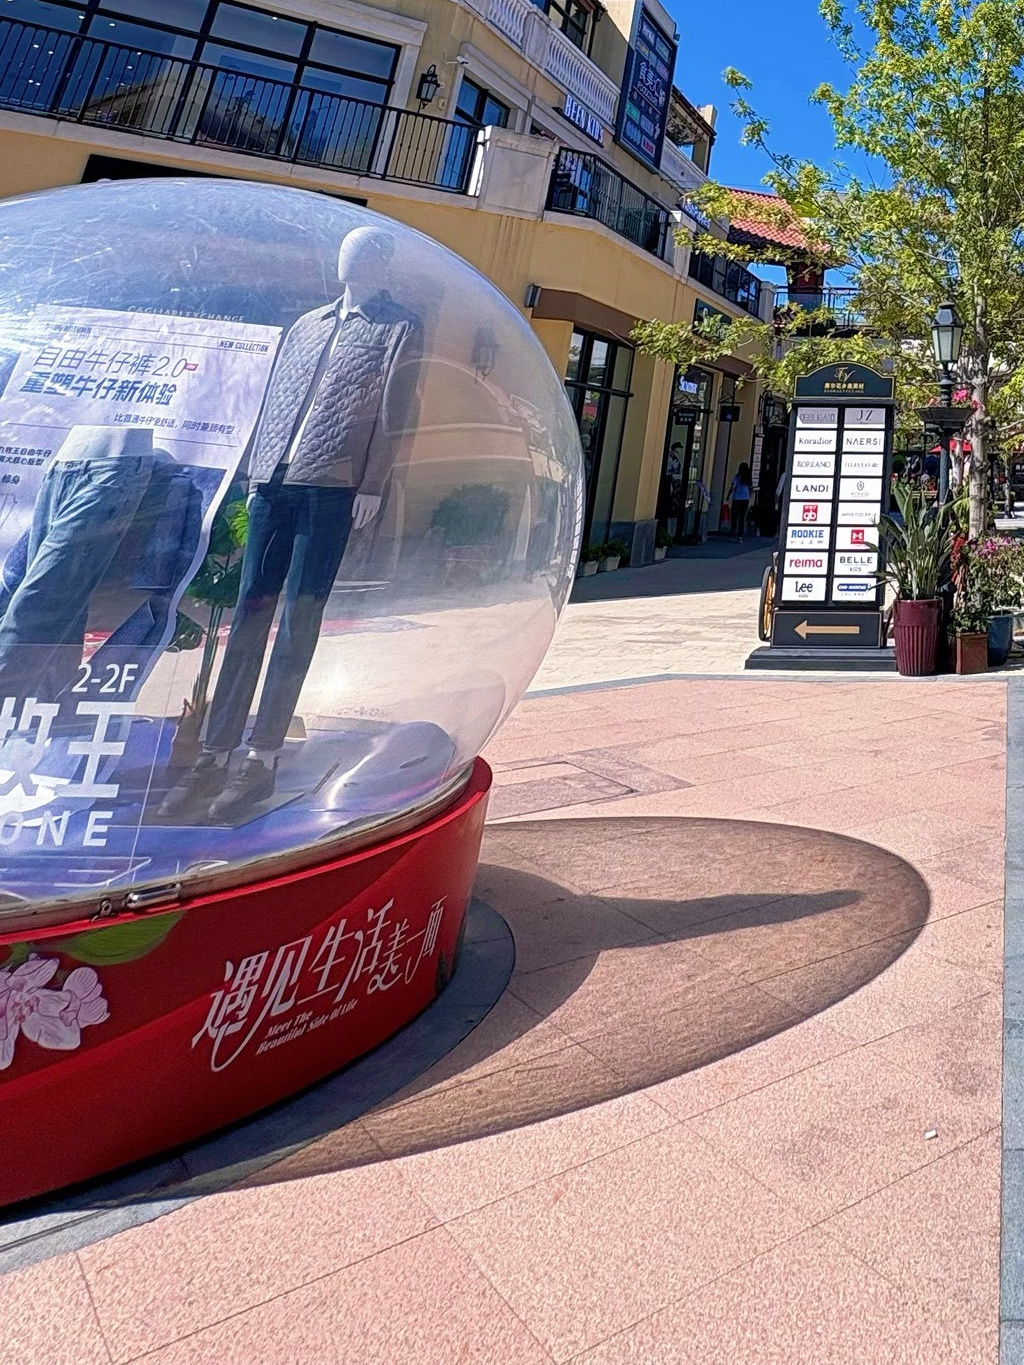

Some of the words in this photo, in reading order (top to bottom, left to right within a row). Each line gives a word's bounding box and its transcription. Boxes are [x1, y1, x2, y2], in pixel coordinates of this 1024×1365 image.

[219, 340, 235, 349] NEW
[20, 370, 177, 406] 重塑牛仔新体验
[798, 437, 833, 446] Koradior
[846, 437, 882, 446] NAERSI
[796, 484, 829, 493] LANDI
[791, 529, 825, 538] ROOKIE
[789, 558, 823, 568] reima
[839, 556, 873, 564] BELLE
[795, 580, 814, 593] Lee
[71, 663, 139, 693] 2-2F
[264, 1019, 293, 1039] Meet
[293, 1011, 313, 1026] The
